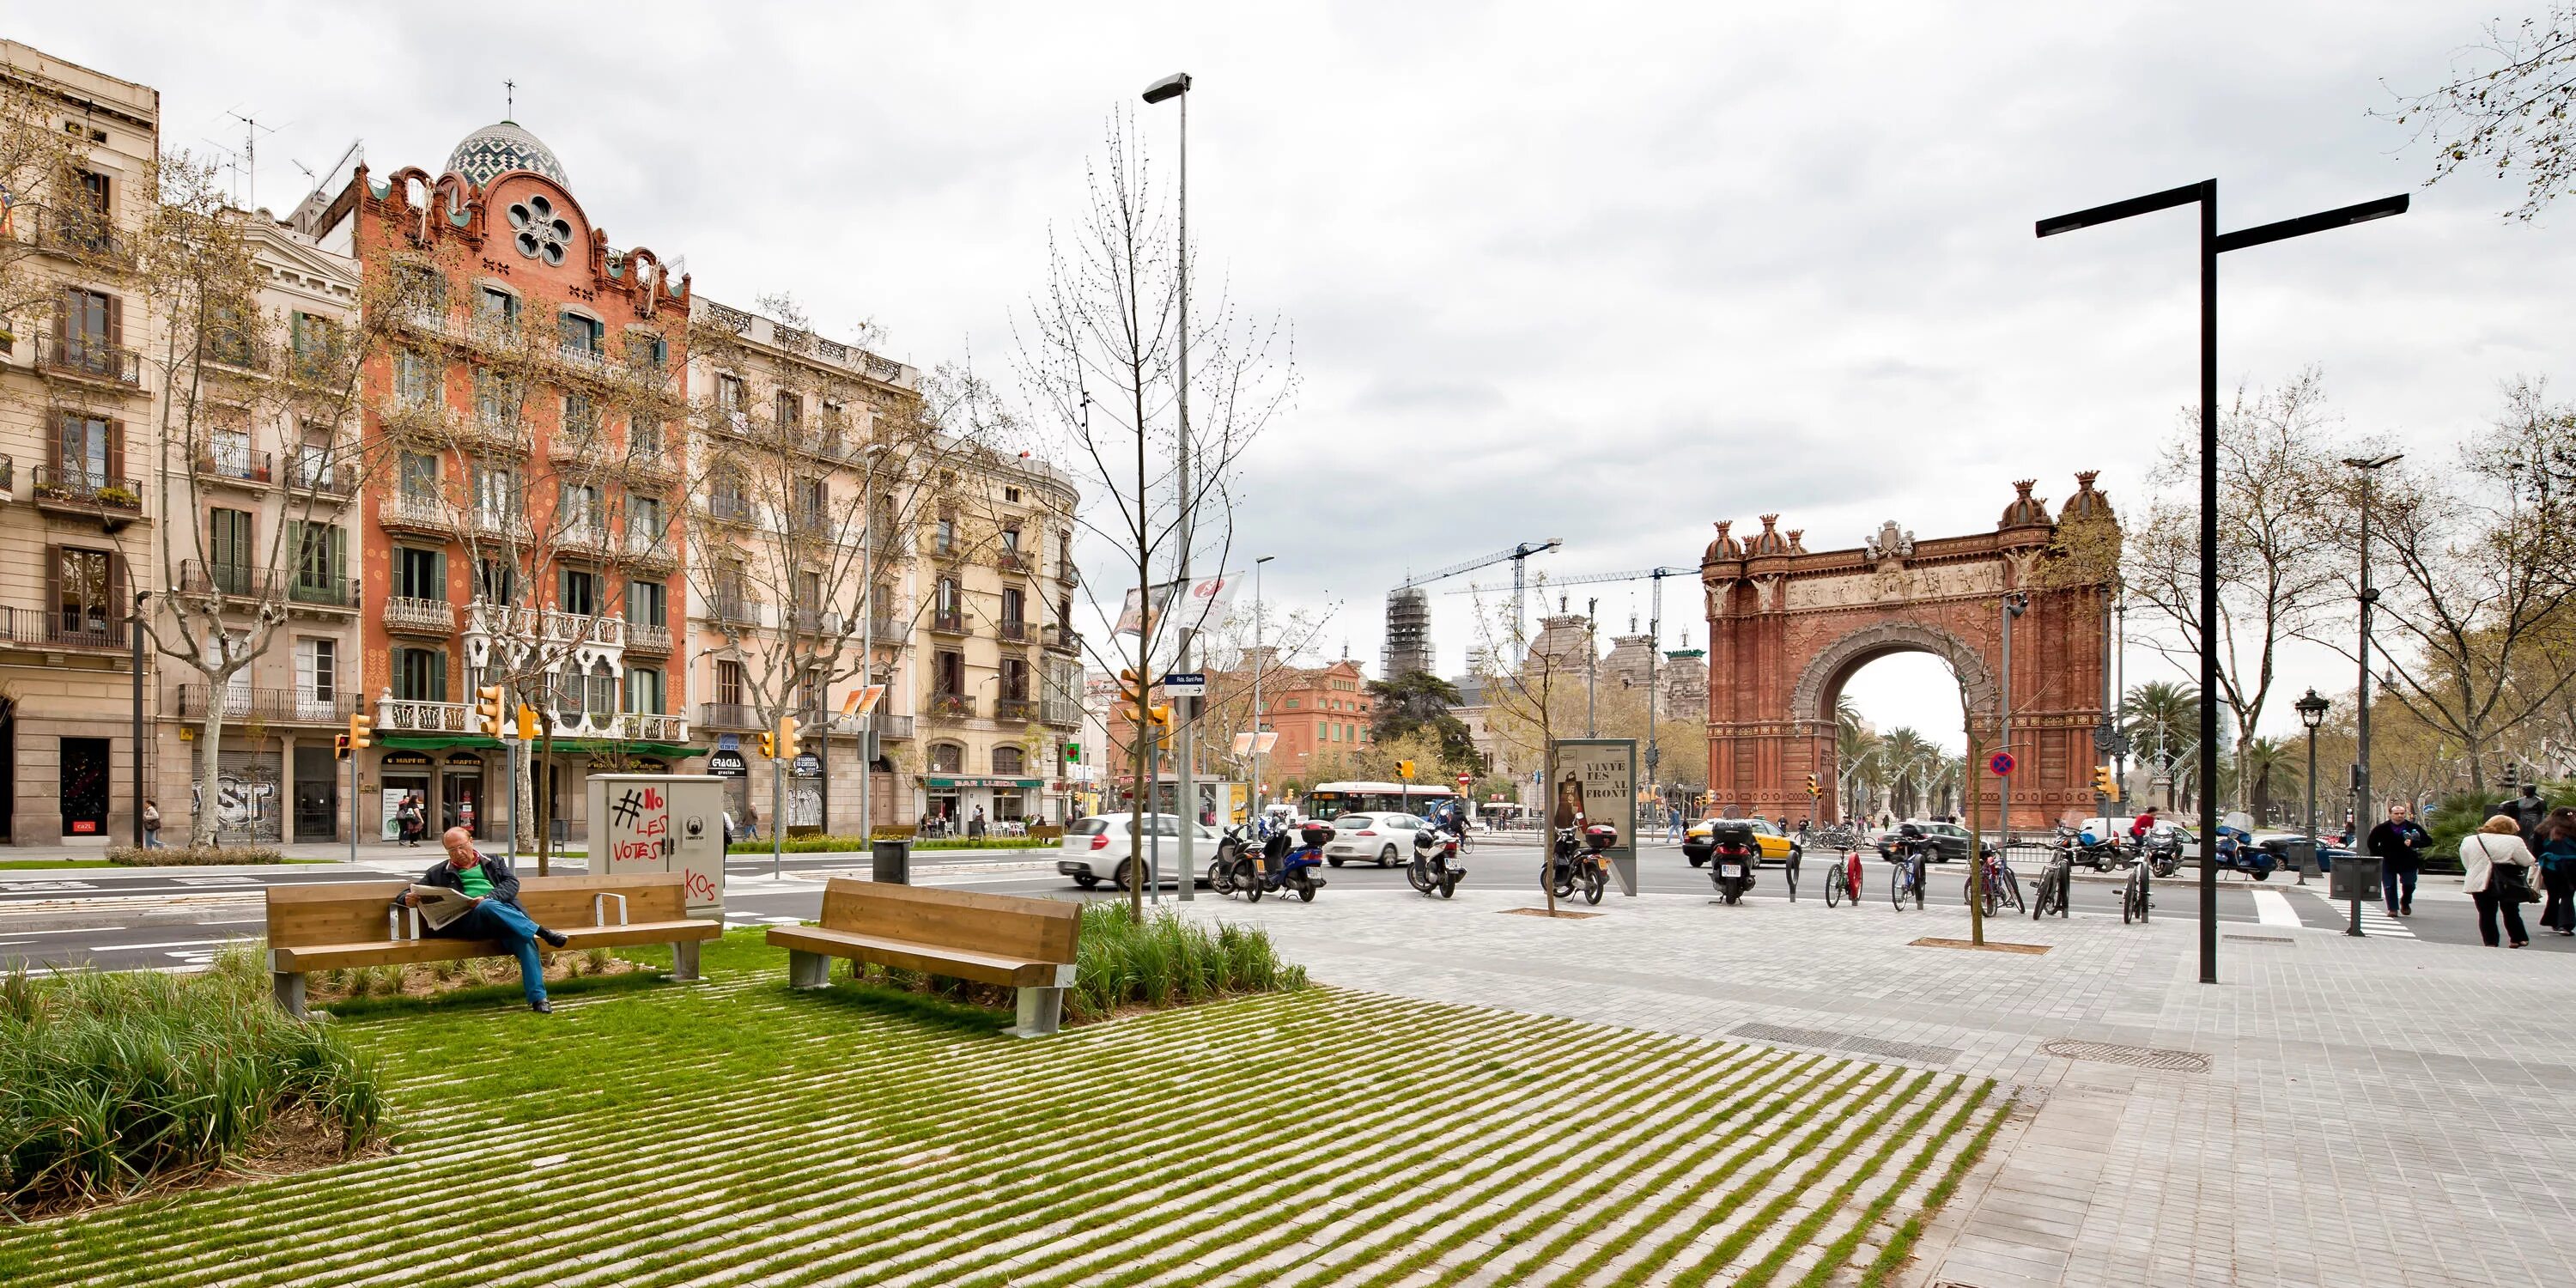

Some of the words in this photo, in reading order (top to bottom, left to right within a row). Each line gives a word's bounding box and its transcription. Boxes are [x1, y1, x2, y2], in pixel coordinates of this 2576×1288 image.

[712, 758, 741, 768] GRACIAS
[1587, 762, 1625, 771] VINYE
[1587, 772, 1609, 781] TES
[1611, 781, 1628, 789] AL
[1586, 789, 1628, 799] FRONT
[636, 815, 668, 837] LES
[614, 840, 663, 861] VOTES
